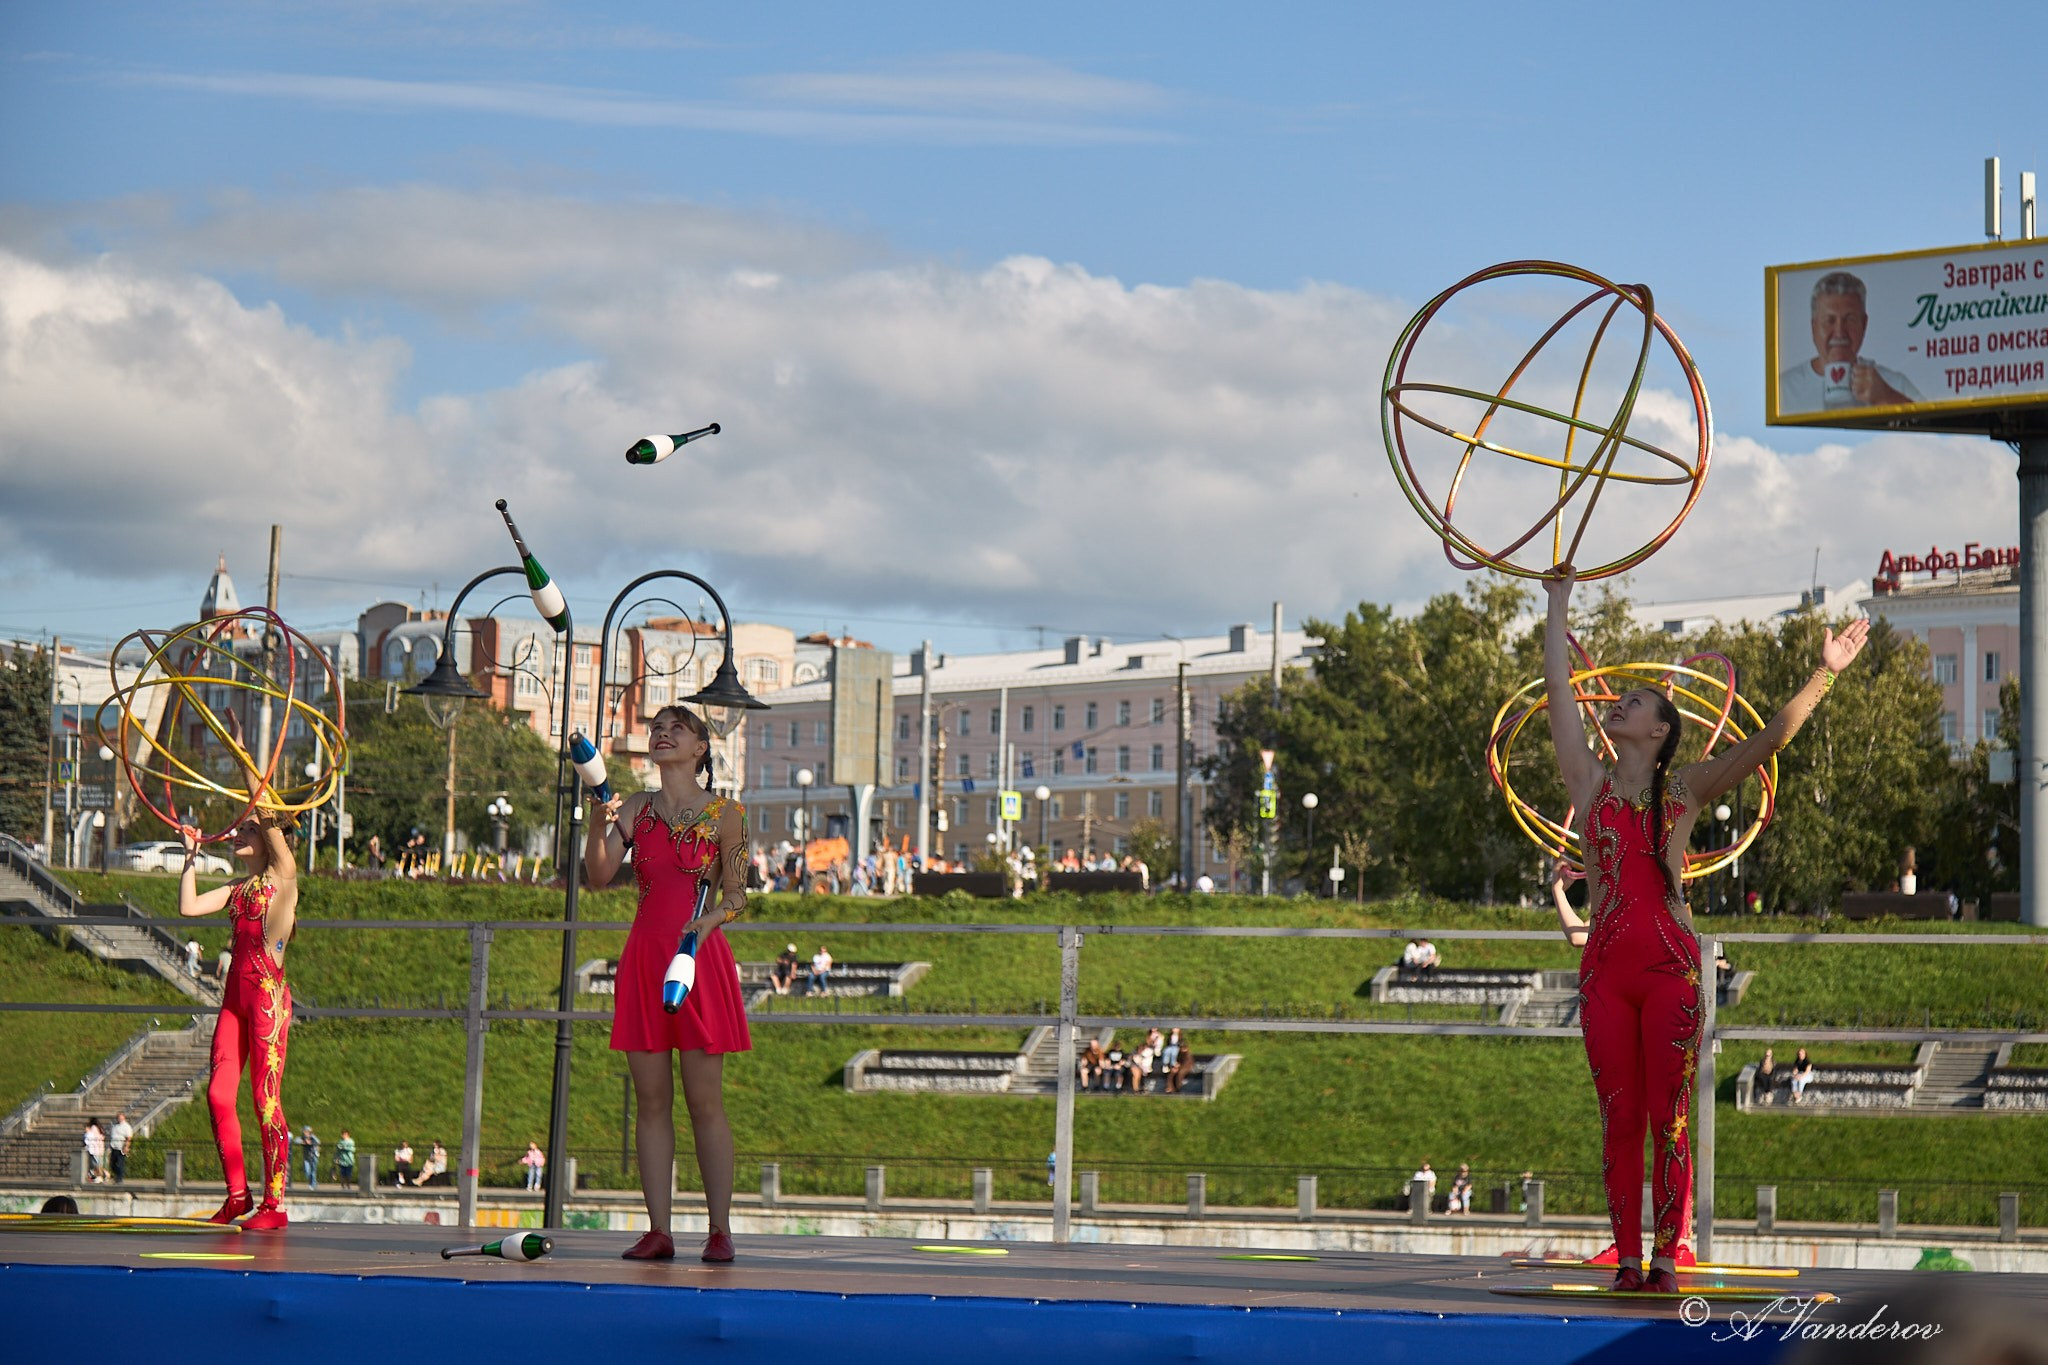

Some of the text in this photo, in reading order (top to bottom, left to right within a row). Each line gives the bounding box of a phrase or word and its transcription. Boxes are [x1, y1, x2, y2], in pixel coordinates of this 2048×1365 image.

[1943, 259, 2044, 290] Завтрак с
[1926, 334, 1979, 357] наша
[1944, 360, 2044, 394] традиция
[1878, 545, 1959, 580] Альфа
